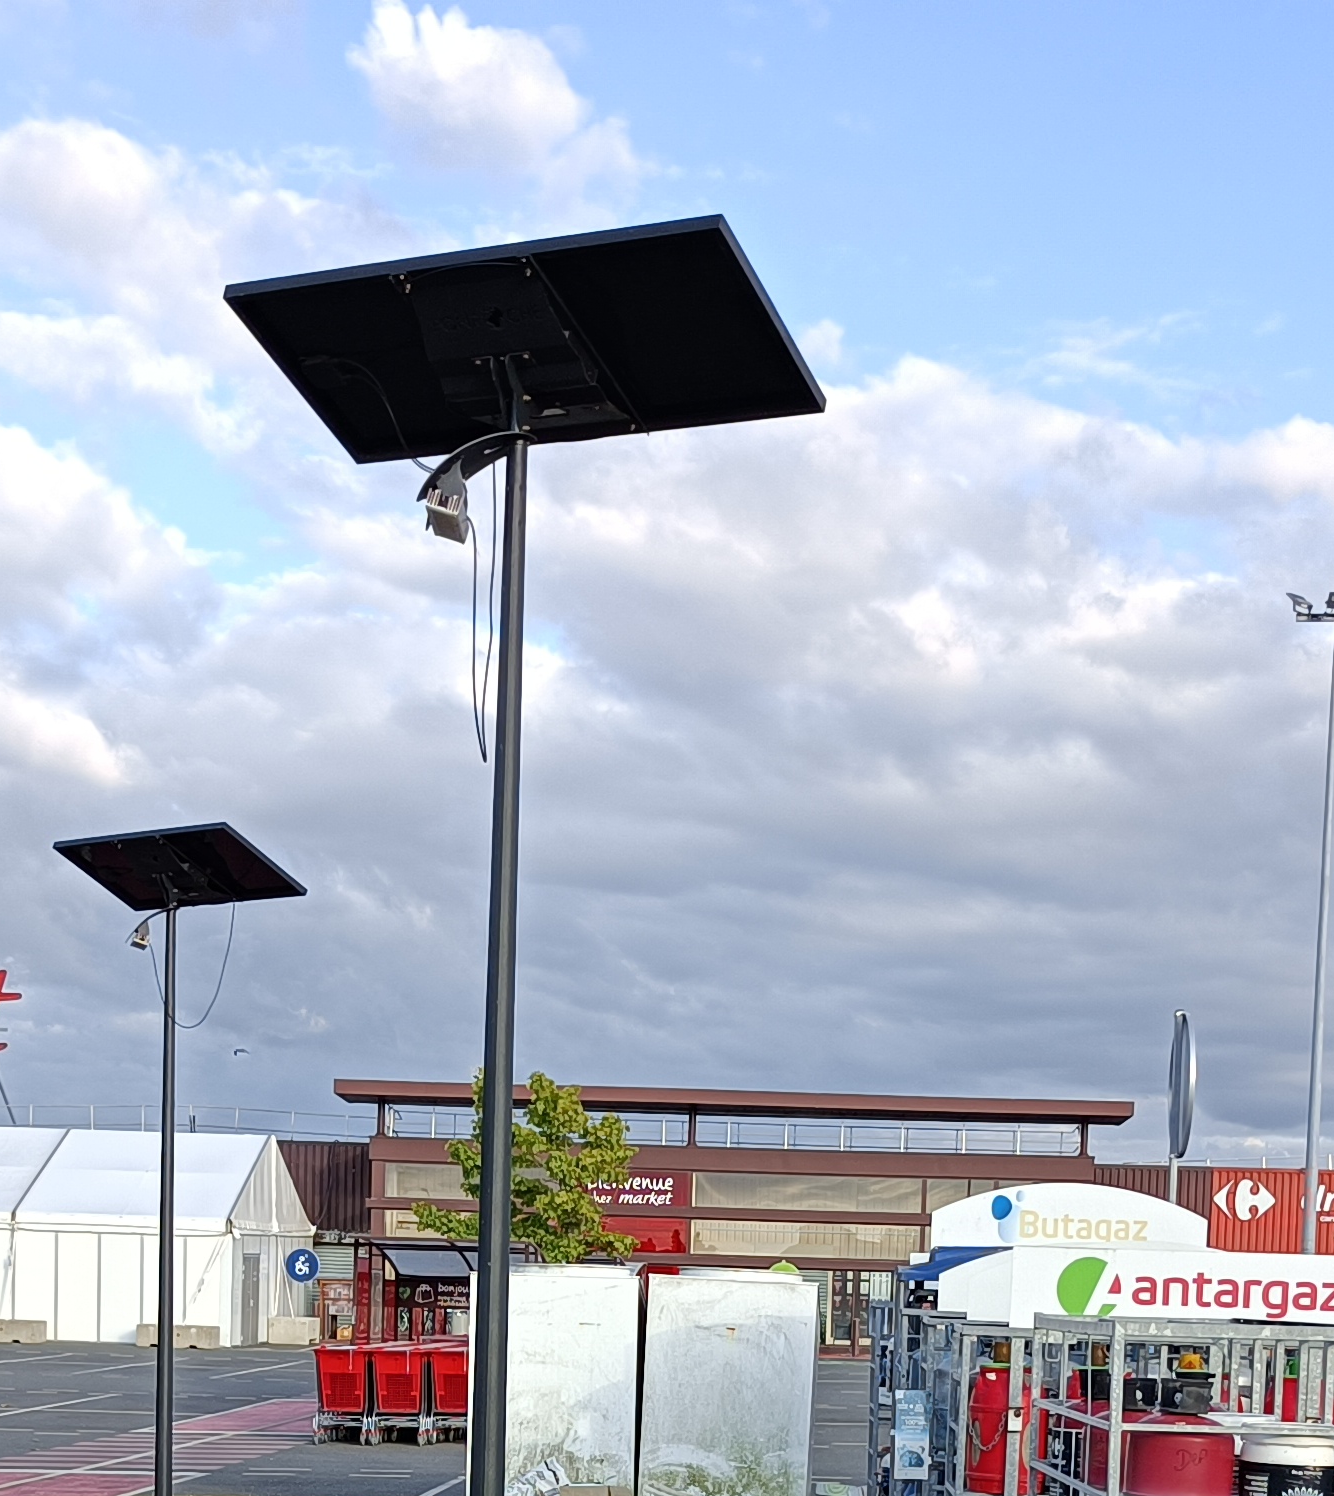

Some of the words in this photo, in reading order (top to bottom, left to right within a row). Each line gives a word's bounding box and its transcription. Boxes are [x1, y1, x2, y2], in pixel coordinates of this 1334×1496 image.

[591, 1190, 612, 1204] hez
[618, 1191, 674, 1206] market
[1018, 1209, 1149, 1243] Butagaz
[437, 1281, 470, 1297] bonjou
